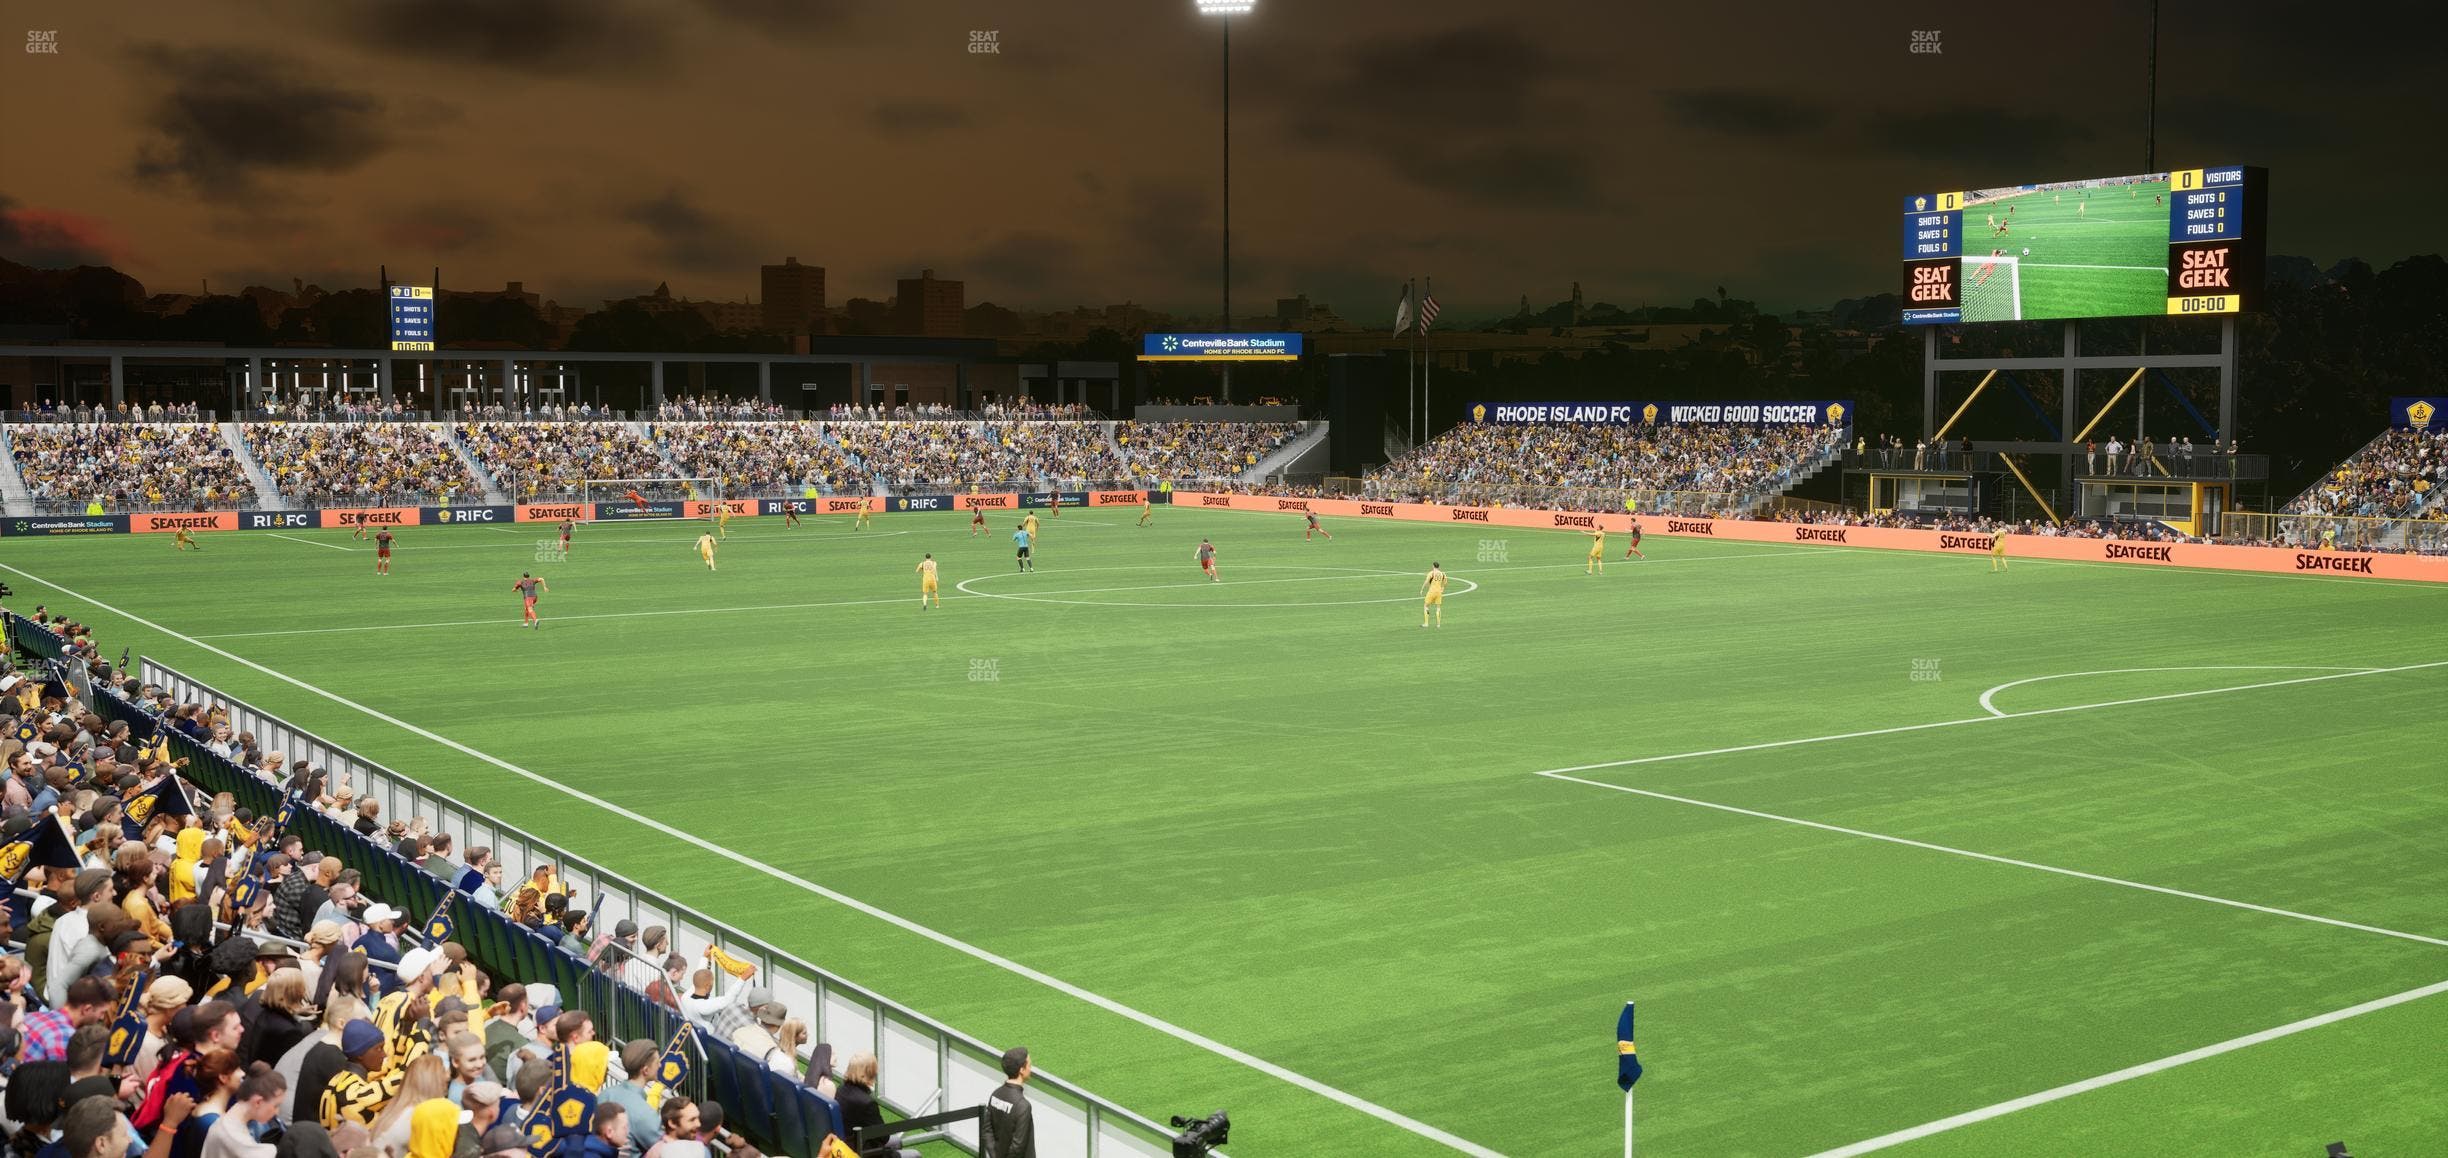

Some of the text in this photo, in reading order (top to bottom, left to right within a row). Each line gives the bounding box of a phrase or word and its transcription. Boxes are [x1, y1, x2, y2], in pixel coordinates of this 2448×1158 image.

[2182, 170, 2242, 188] 0 VISITORS
[1946, 194, 1953, 209] 0
[2188, 192, 2225, 205] SHOTS 0
[1918, 215, 1949, 226] SHOTS 0
[2187, 207, 2224, 220] SAVES 0
[1918, 229, 1948, 240] SAVES 0
[2187, 222, 2224, 235] FOULS 0
[1918, 242, 1948, 253] FOULS 0
[2182, 248, 2229, 269] SEAT
[1913, 265, 1951, 284] SEAT
[2179, 268, 2230, 289] GEEK
[1911, 283, 1952, 301] GEEK
[2181, 296, 2226, 312] 00:00
[1250, 338, 1285, 347] Stadium
[1496, 405, 1631, 422] RHODE ISLAND FC
[1671, 405, 1816, 423] WICKED GOOD SOCCER
[911, 498, 938, 509] RIFC
[1099, 493, 1138, 505] SEATGEEK
[1203, 496, 1230, 507] SEATGEEK
[456, 509, 494, 522] RIFC
[529, 506, 581, 520] SEATGEEK
[1361, 504, 1394, 517] SEATGEEK
[1452, 508, 1489, 522] SEATGEEK
[150, 515, 219, 530] SEATGEEK
[253, 513, 308, 528] RI FC
[1554, 513, 1595, 528] SEATGEEK
[1667, 520, 1713, 536] SEATGEEK
[1796, 527, 1847, 543] SEATGEEK
[2105, 543, 2172, 562] SEATGEEK
[2295, 553, 2373, 574] SEATGEEK
